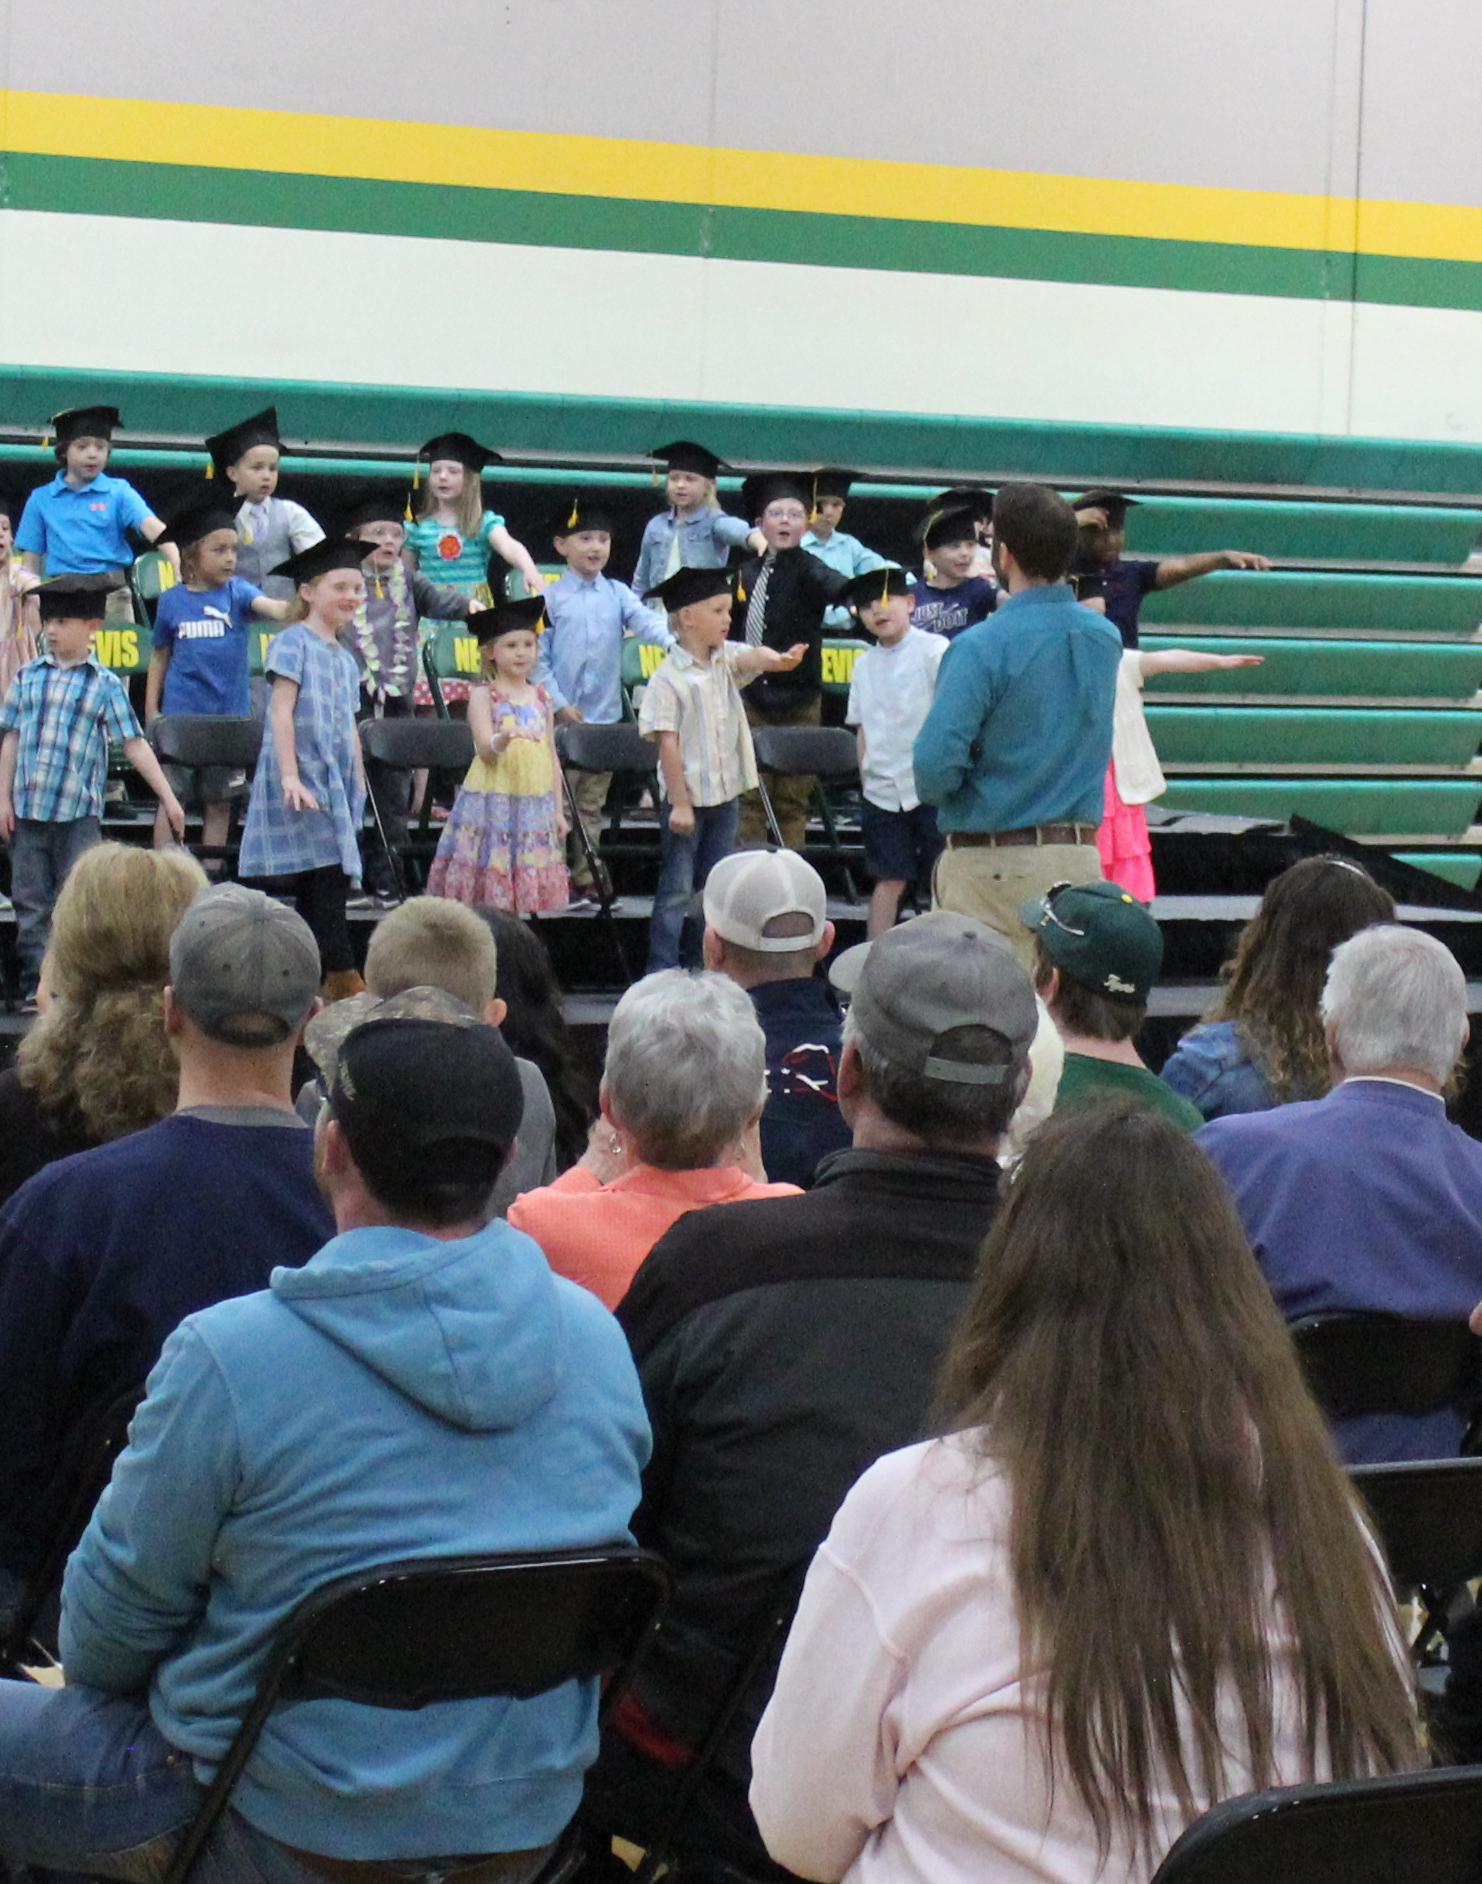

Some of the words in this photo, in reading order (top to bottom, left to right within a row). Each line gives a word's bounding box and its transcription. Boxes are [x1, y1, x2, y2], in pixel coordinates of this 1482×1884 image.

[178, 620, 226, 639] PUMA
[86, 629, 140, 668] VIS
[821, 648, 865, 683] EVI
